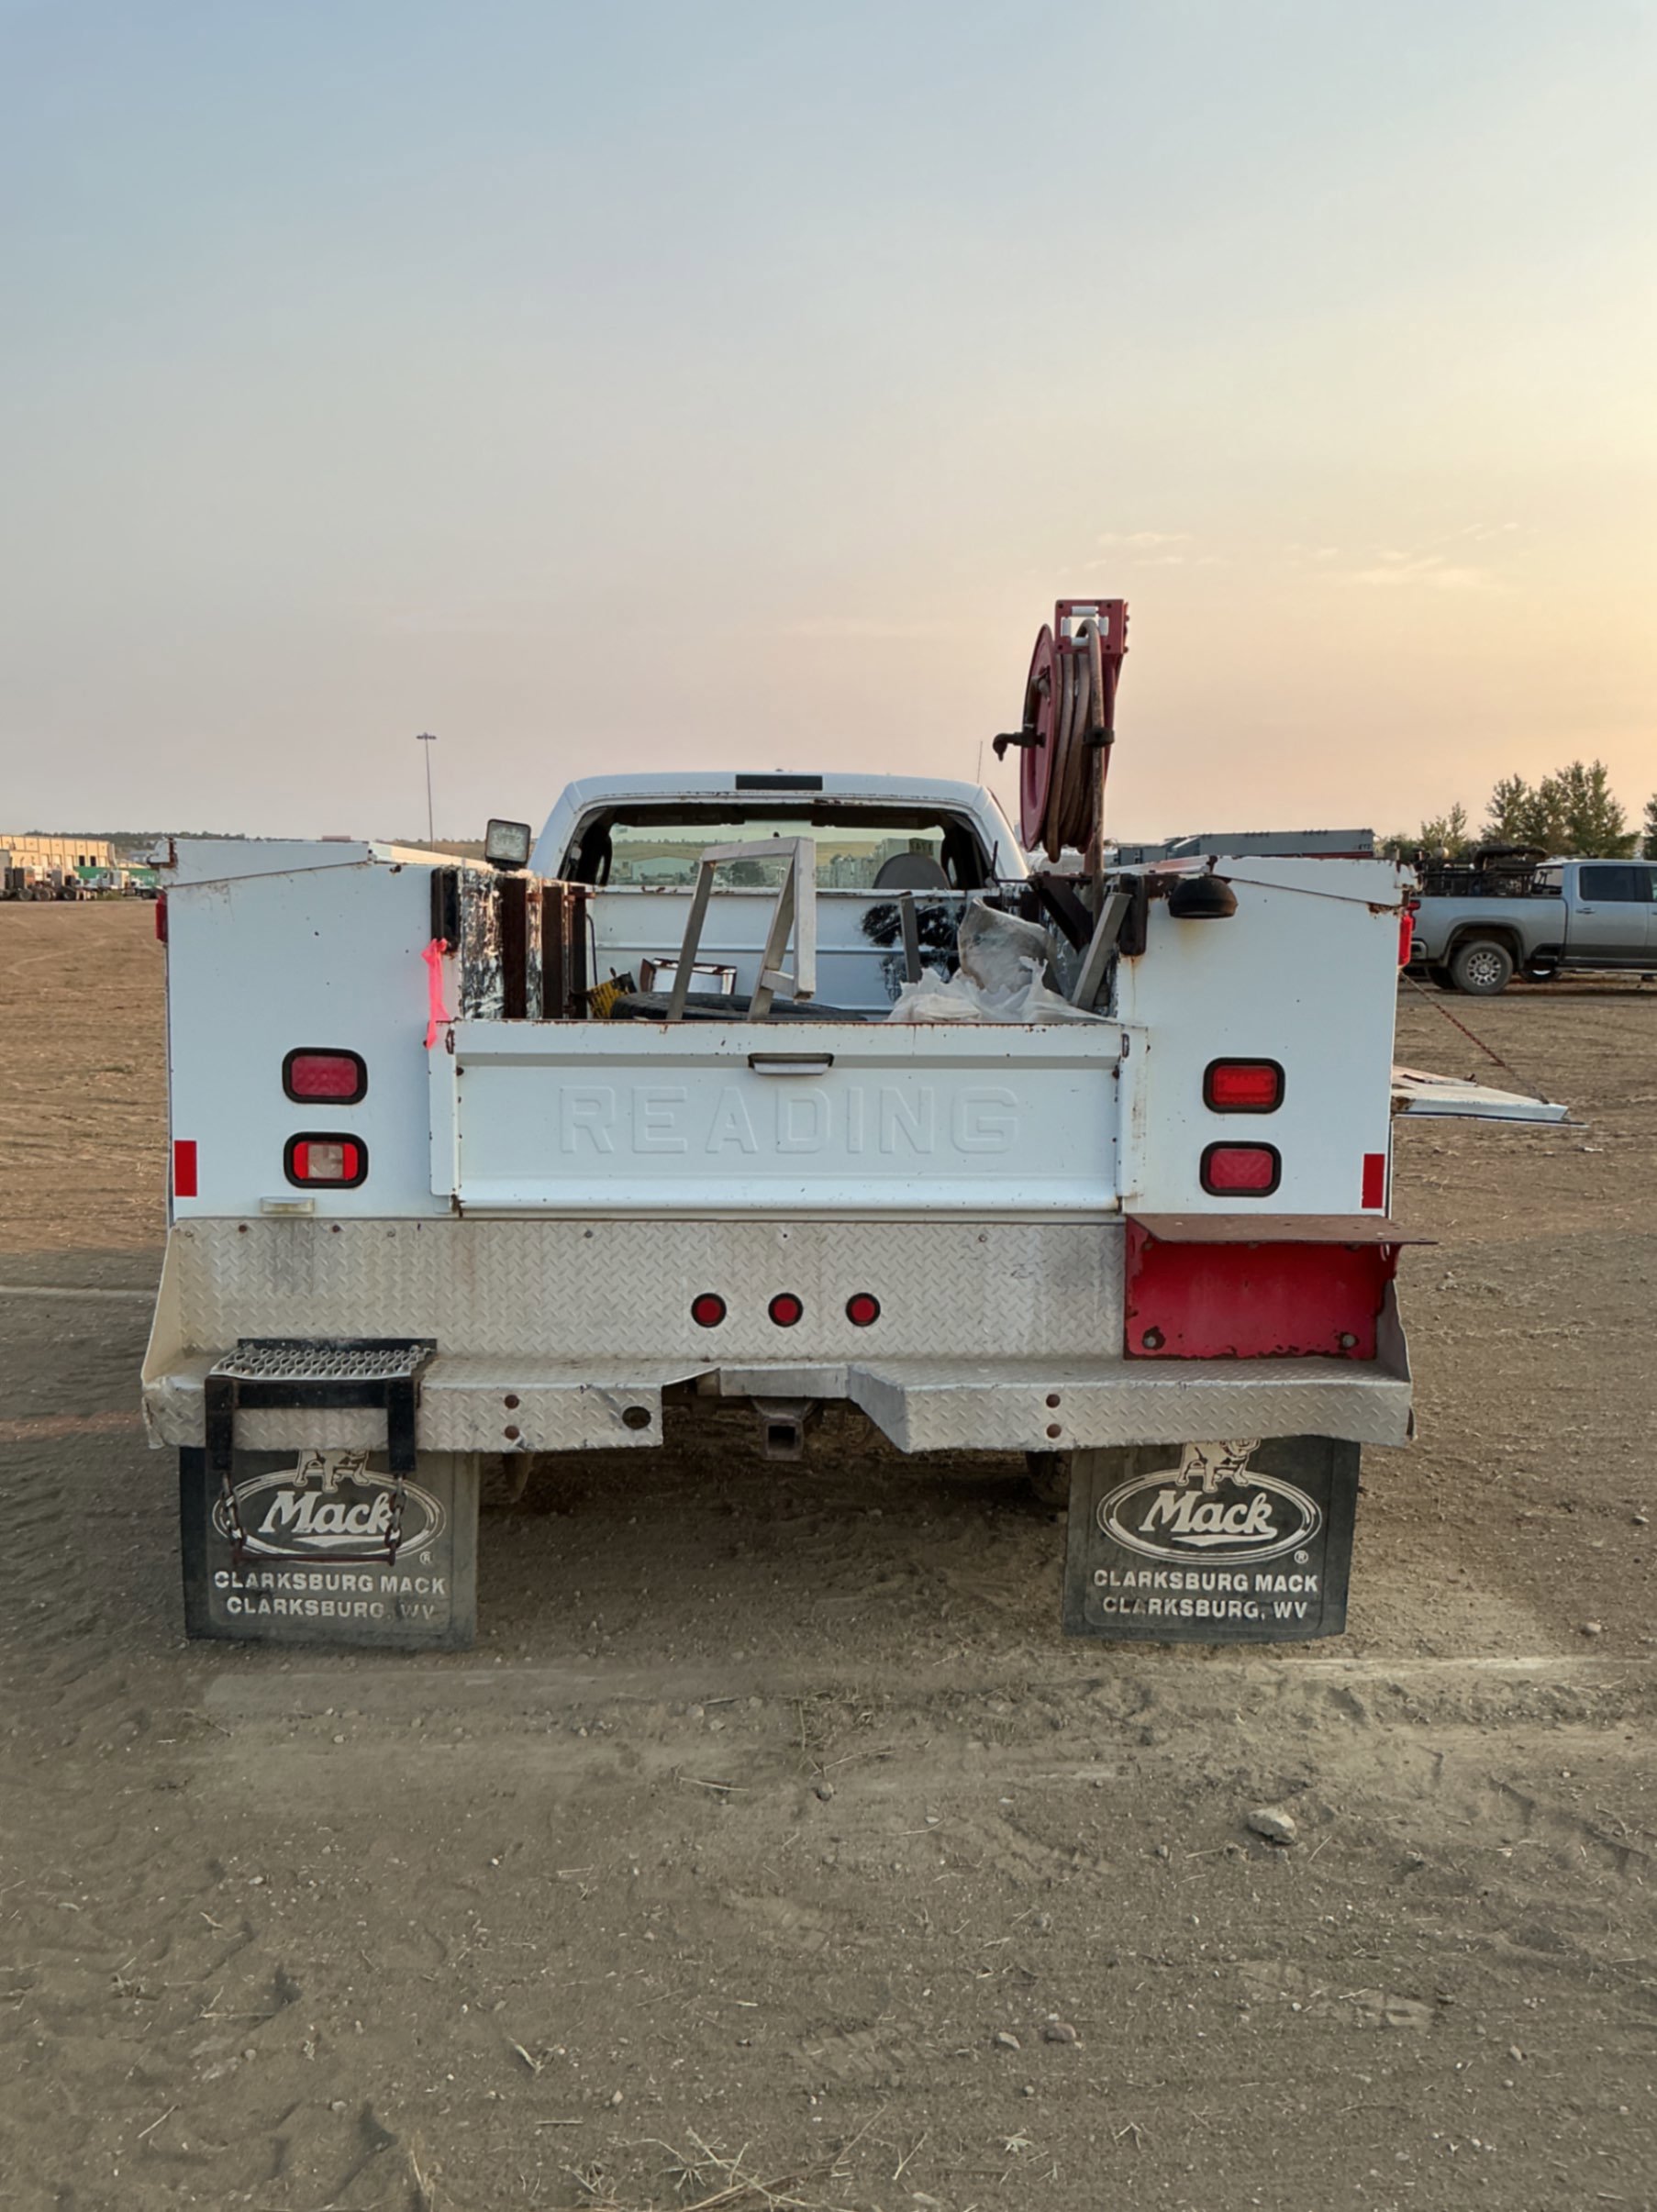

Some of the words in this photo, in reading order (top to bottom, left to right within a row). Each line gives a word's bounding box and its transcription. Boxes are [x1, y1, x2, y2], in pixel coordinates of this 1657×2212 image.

[559, 1085, 1019, 1154] READING
[258, 1490, 395, 1534] Mack
[1139, 1490, 1277, 1534] Mack
[214, 1570, 373, 1593] CLARKSBURG
[380, 1575, 446, 1595] MACK
[1094, 1569, 1249, 1592] CLARKSBURG
[1254, 1573, 1318, 1593] MACK
[400, 1603, 435, 1620] WV
[1273, 1601, 1308, 1619] WV
